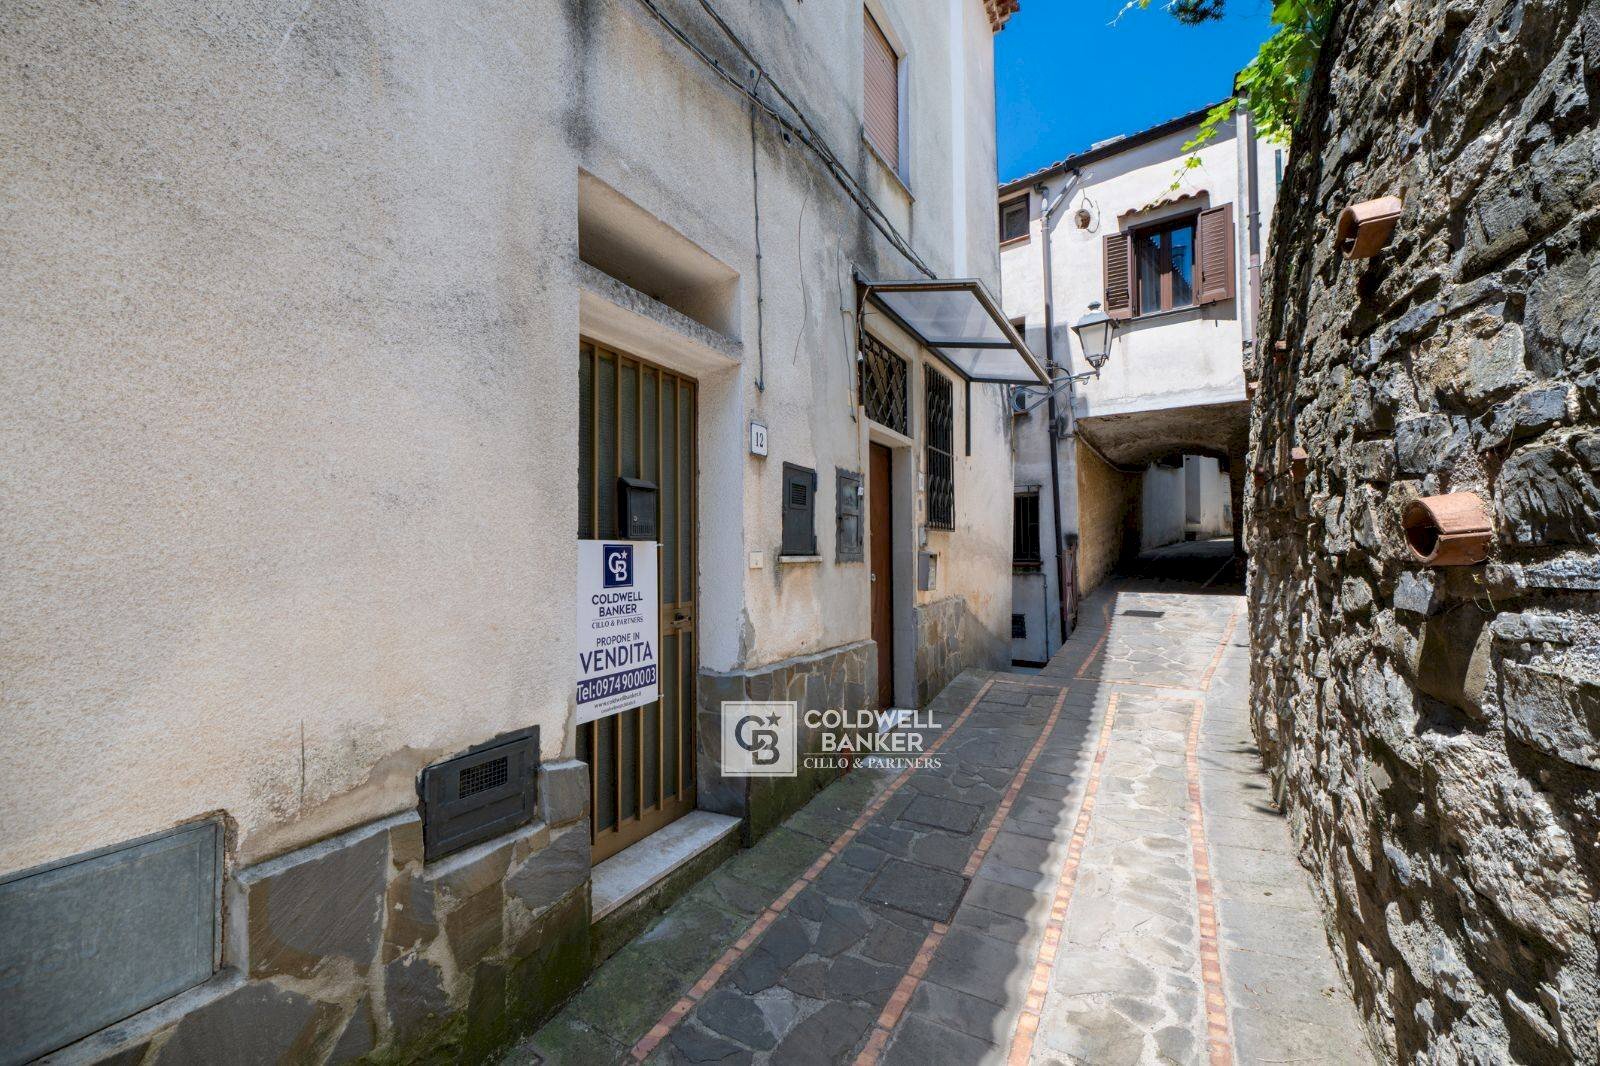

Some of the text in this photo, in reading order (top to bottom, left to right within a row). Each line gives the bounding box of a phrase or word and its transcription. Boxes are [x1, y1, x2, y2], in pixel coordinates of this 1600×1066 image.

[756, 432, 764, 448] 12
[591, 591, 643, 605] COLDWELL
[599, 604, 637, 617] BANKER
[591, 620, 610, 629] CILLO
[616, 616, 644, 626] PARTNERS
[596, 631, 640, 647] PROPONE IN
[579, 641, 653, 674] VENDITA
